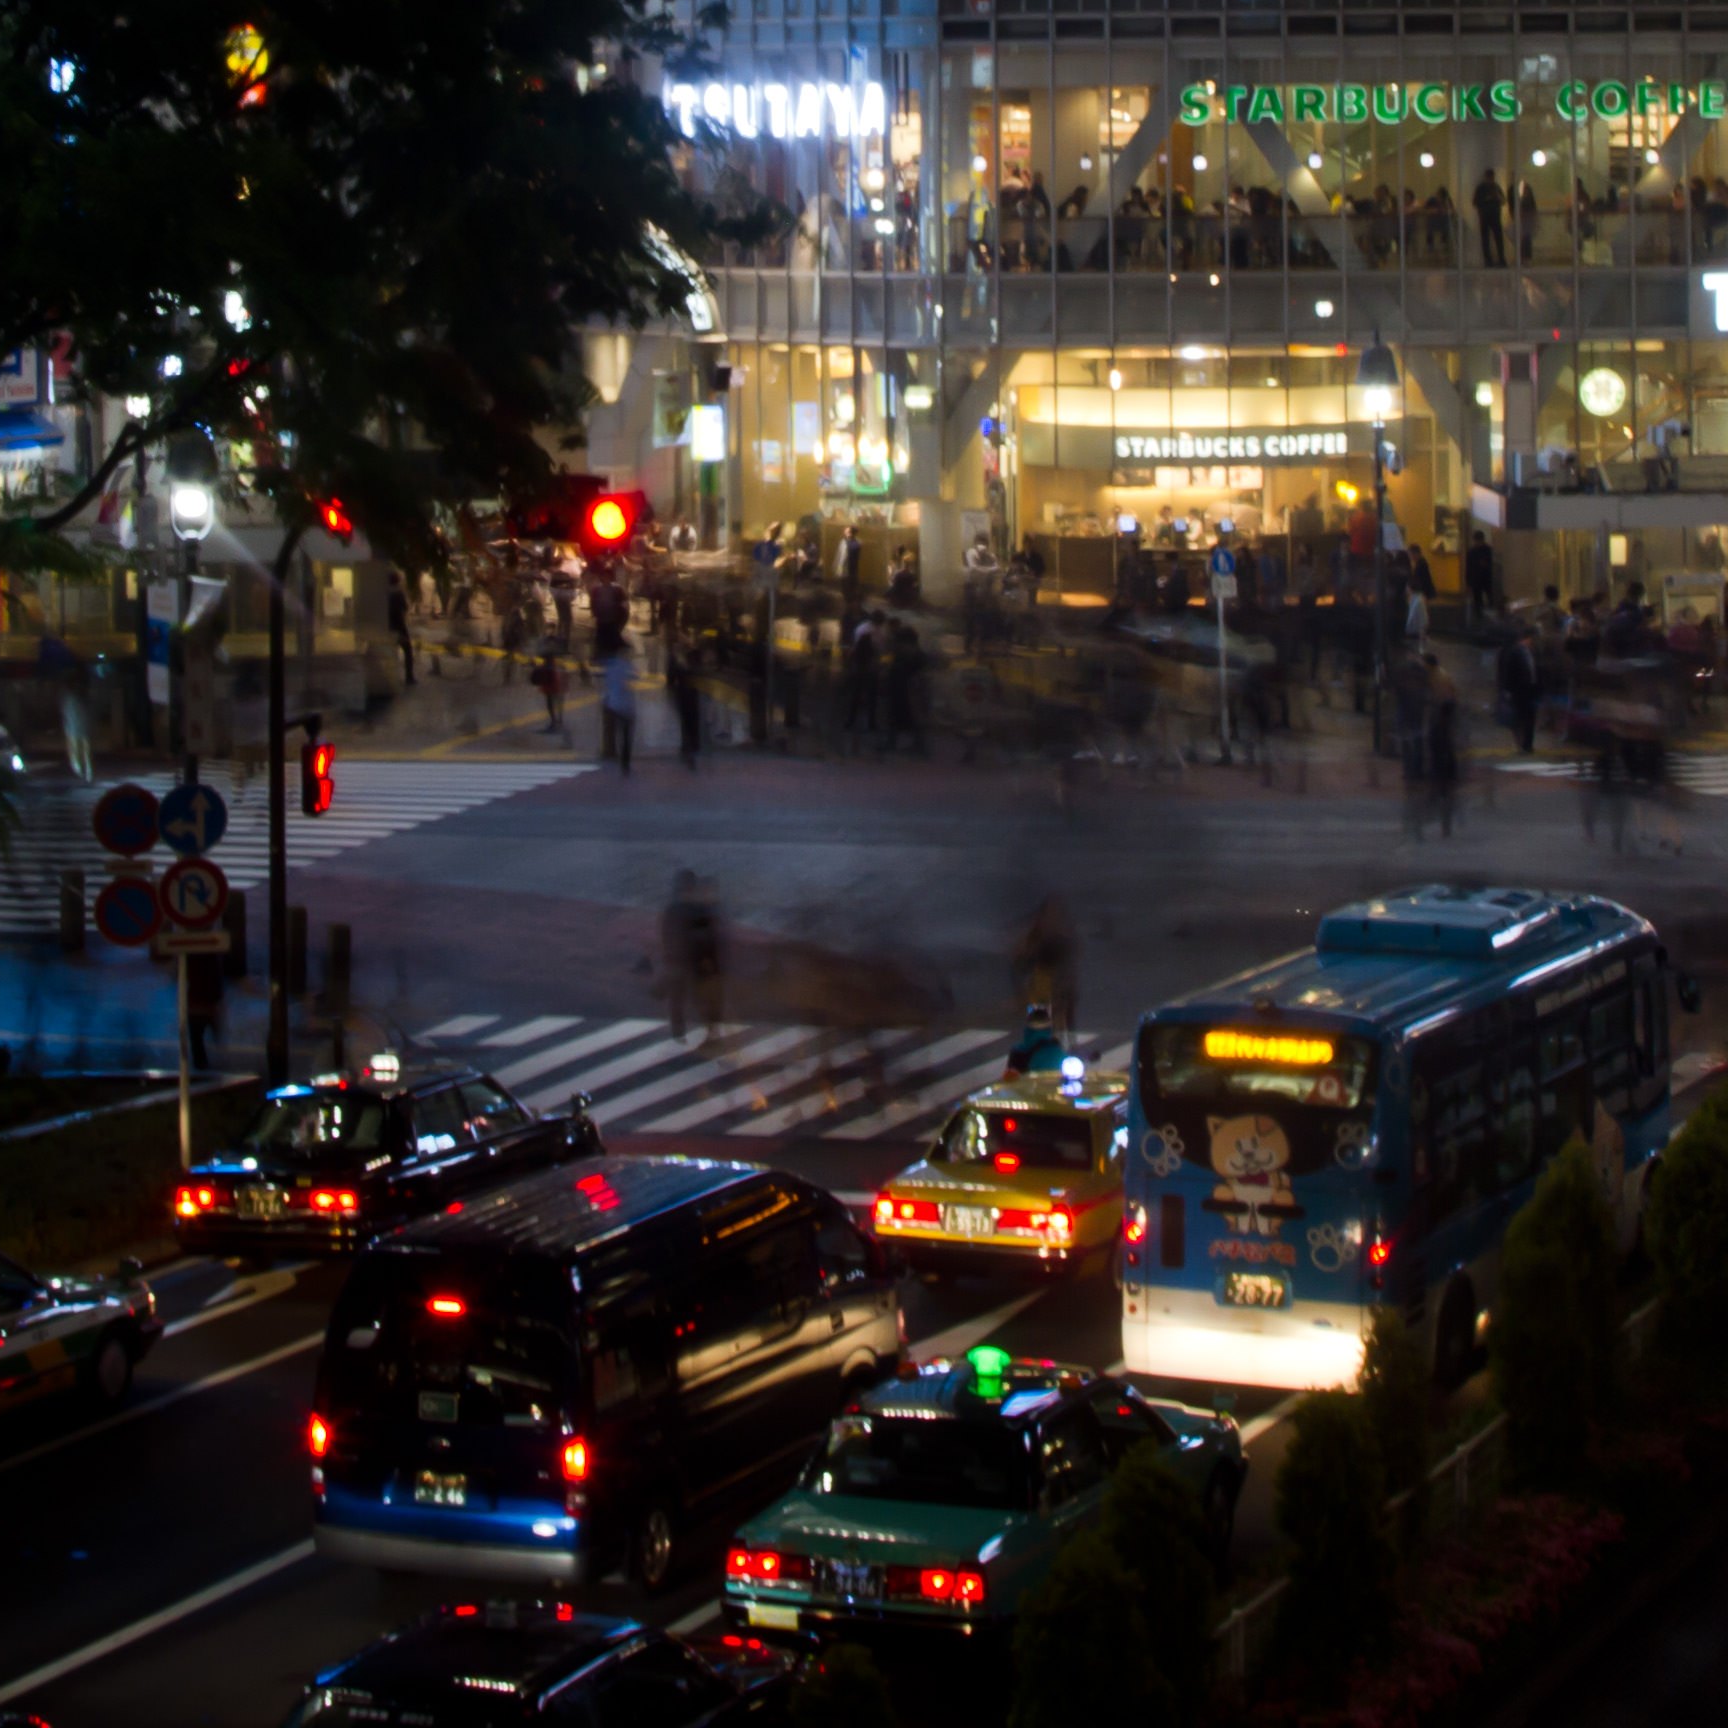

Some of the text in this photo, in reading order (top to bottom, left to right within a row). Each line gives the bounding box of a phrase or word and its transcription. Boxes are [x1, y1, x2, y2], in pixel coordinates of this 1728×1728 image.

[670, 80, 886, 139] TSUTAYA
[1180, 83, 1521, 126] STARBUCKS
[1116, 432, 1348, 460] STARBUCKS COFFEE
